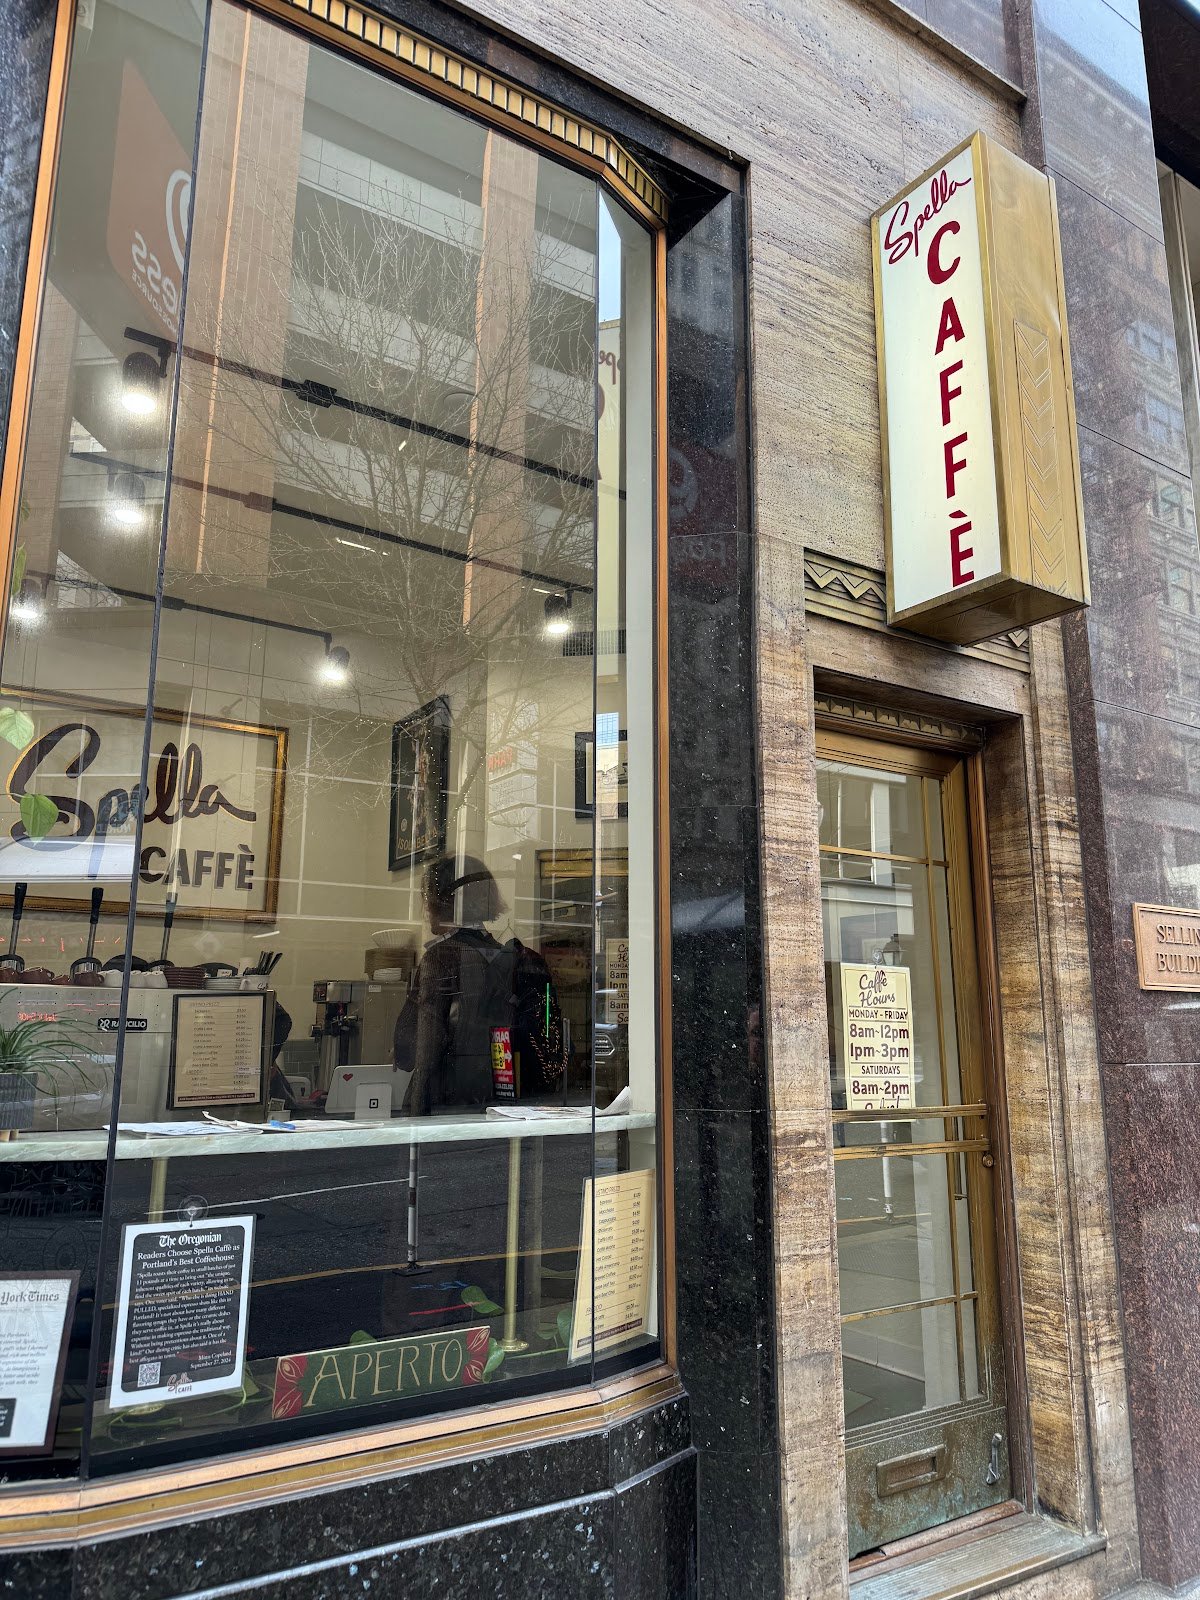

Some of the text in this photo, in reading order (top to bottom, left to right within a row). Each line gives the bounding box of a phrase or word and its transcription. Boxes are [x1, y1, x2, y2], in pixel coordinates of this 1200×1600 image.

[884, 170, 971, 264] Spella
[926, 220, 974, 587] CAFFÈ
[6, 723, 256, 880] Spella
[139, 844, 254, 890] CAFFÈ
[1156, 924, 1200, 946] SELLIN
[1156, 953, 1200, 974] BUILDI
[860, 970, 888, 994] Caffè
[859, 990, 896, 1008] Hours
[849, 1008, 878, 1018] MONDAY
[884, 1010, 908, 1020] FRIDAY
[862, 1065, 900, 1075] SATURDAYS
[159, 1232, 222, 1249] The Oregonian
[138, 1250, 166, 1260] Readers
[167, 1248, 192, 1257] Choose
[193, 1246, 214, 1256] Spella
[179, 1257, 194, 1265] Best
[195, 1253, 234, 1264] Coffeehouse
[0, 1290, 60, 1306] York Times
[190, 1360, 212, 1370] September
[304, 1338, 463, 1408] APERTO
[166, 1372, 192, 1394] Spella
